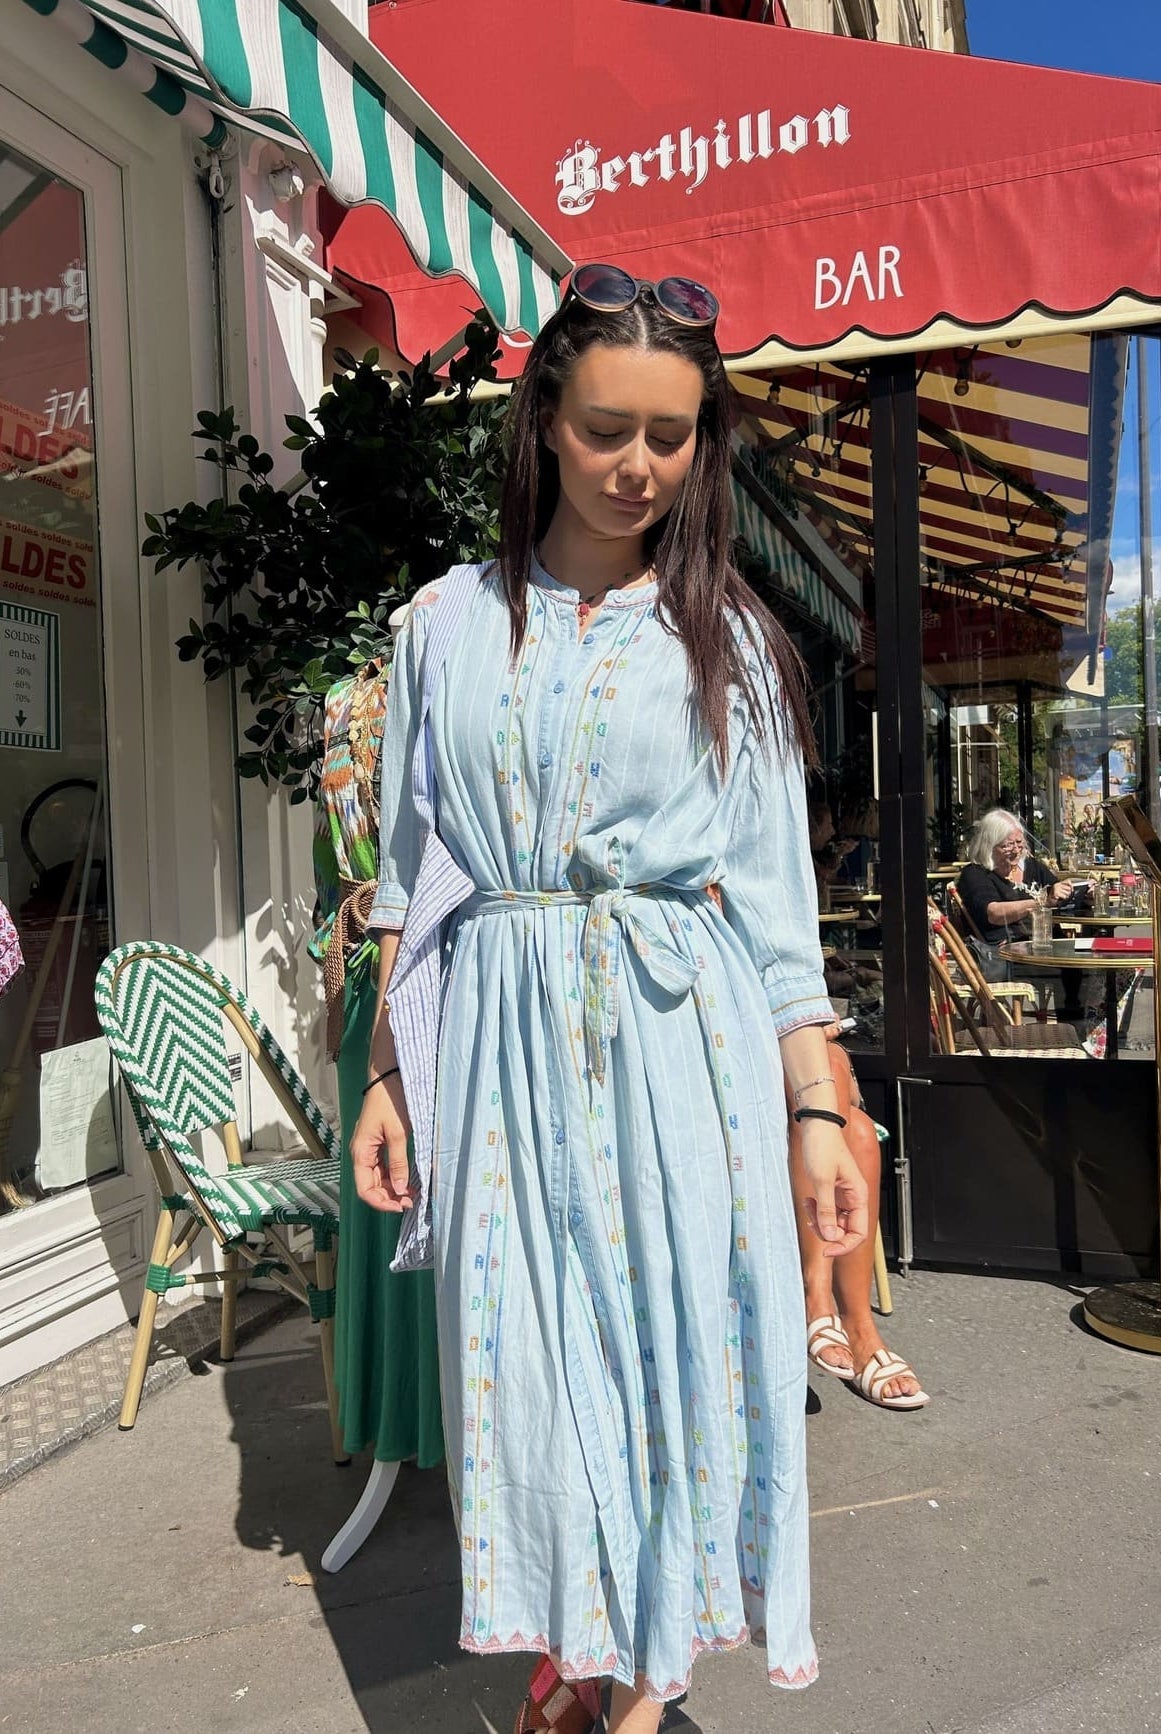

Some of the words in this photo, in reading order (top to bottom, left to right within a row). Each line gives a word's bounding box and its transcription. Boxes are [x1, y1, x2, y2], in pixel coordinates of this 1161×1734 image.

[555, 103, 851, 216] Berthillon
[814, 245, 904, 310] BAR
[6, 522, 38, 537] soldes
[41, 532, 72, 547] soldes
[1, 535, 87, 590] LDES
[3, 580, 36, 594] soldes
[39, 589, 70, 602] soldes
[4, 628, 41, 645] SOLDES
[9, 648, 20, 658] en
